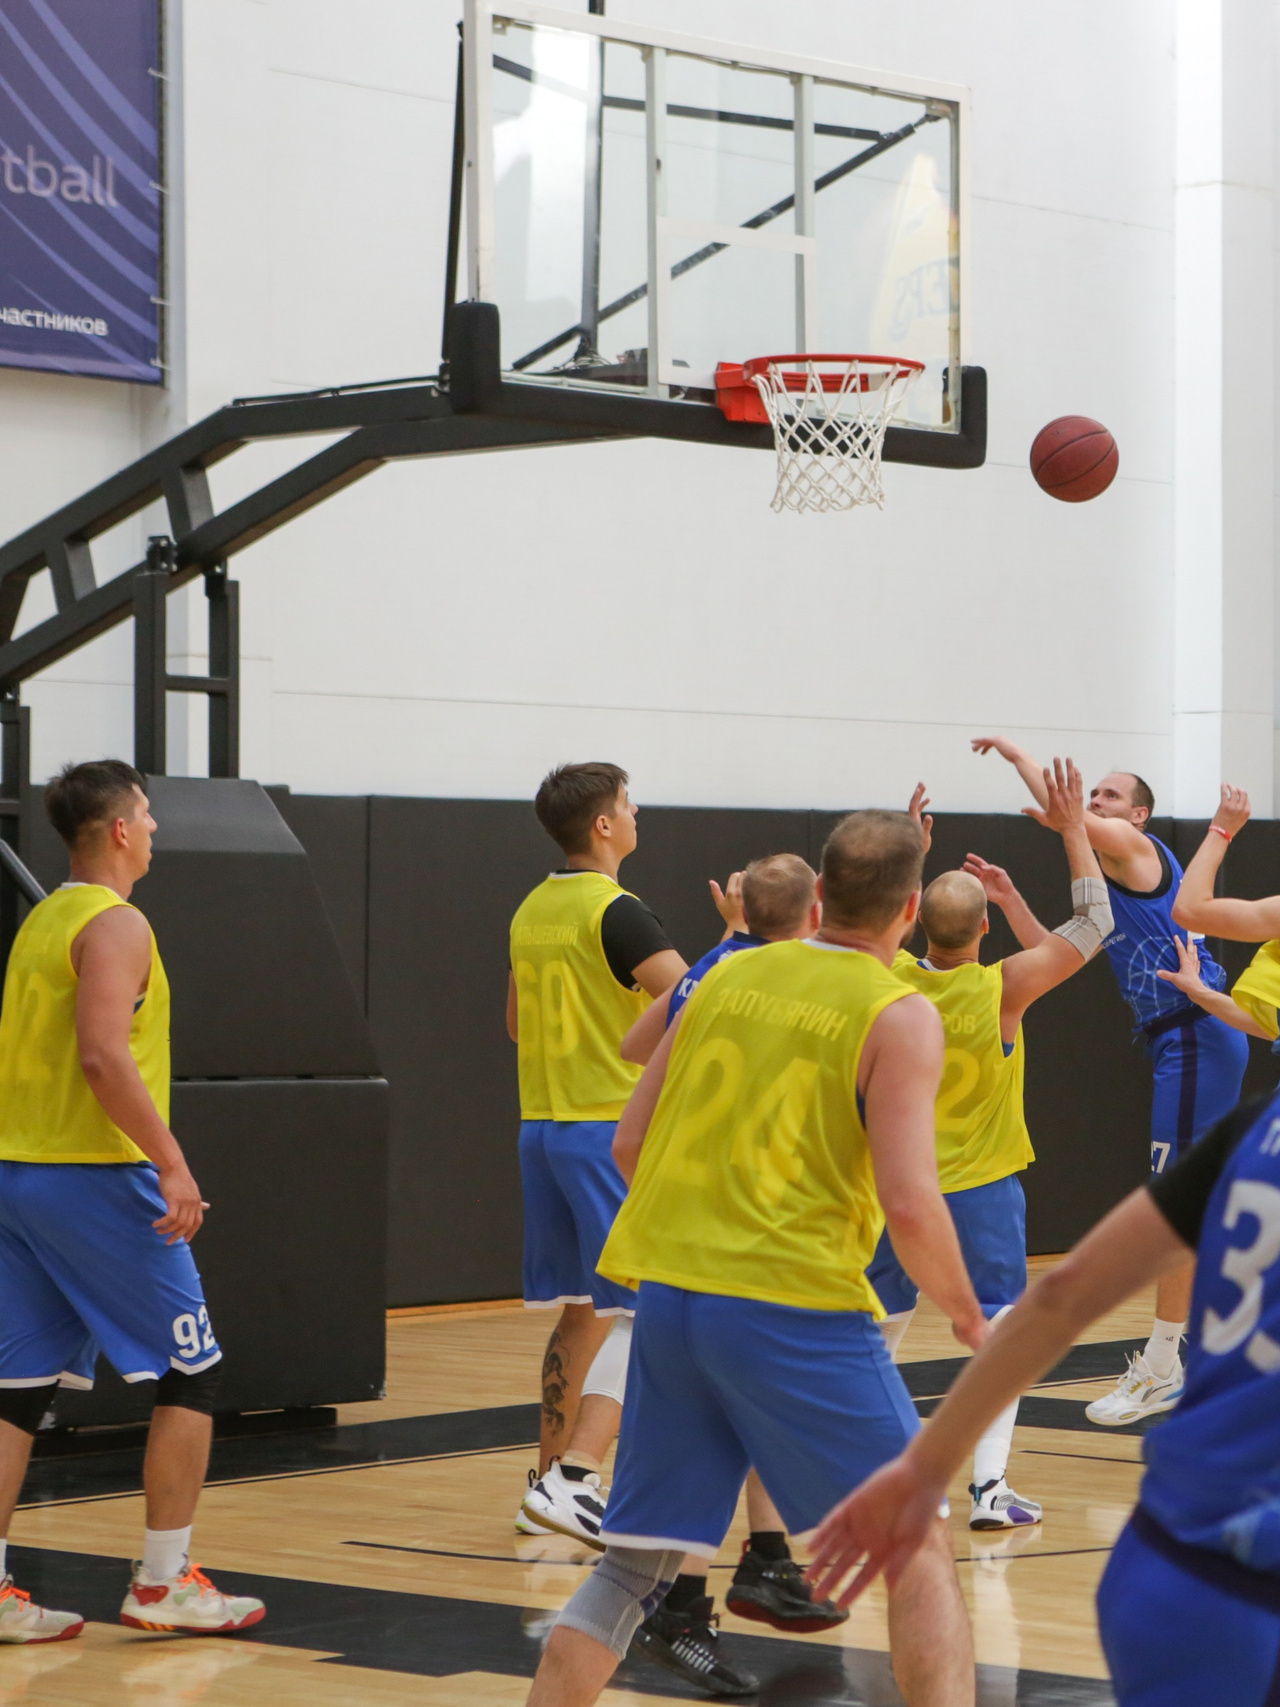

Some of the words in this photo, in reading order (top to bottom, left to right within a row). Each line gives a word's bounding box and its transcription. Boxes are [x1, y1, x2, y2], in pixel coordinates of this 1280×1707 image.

[0, 144, 120, 209] tball
[658, 1037, 820, 1206] 24
[1150, 1140, 1171, 1174] 7
[172, 1304, 217, 1359] 92
